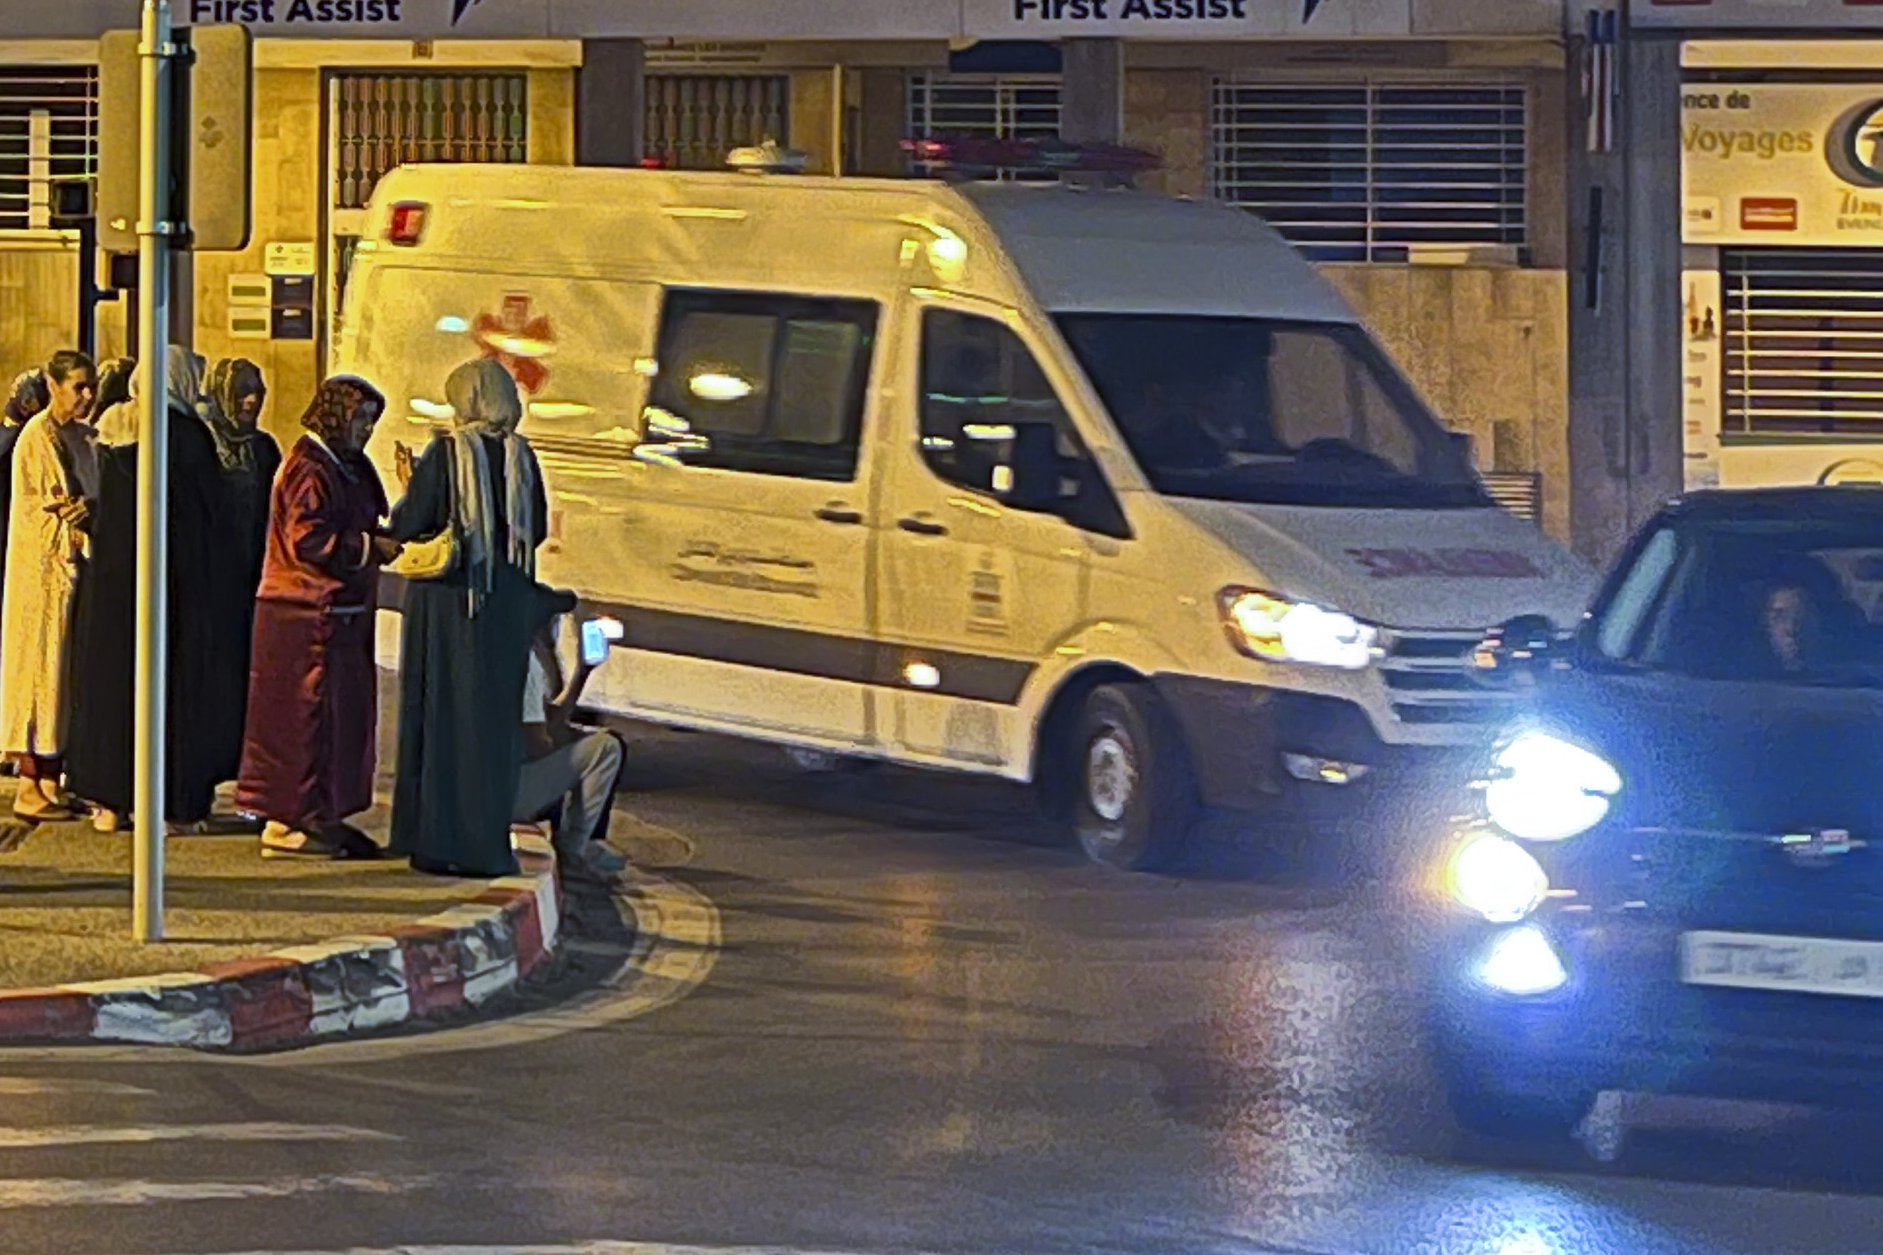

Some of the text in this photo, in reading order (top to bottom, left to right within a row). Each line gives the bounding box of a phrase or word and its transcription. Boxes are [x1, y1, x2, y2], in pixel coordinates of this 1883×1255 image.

[1682, 89, 1750, 109] nce de
[1682, 122, 1813, 159] Voyages
